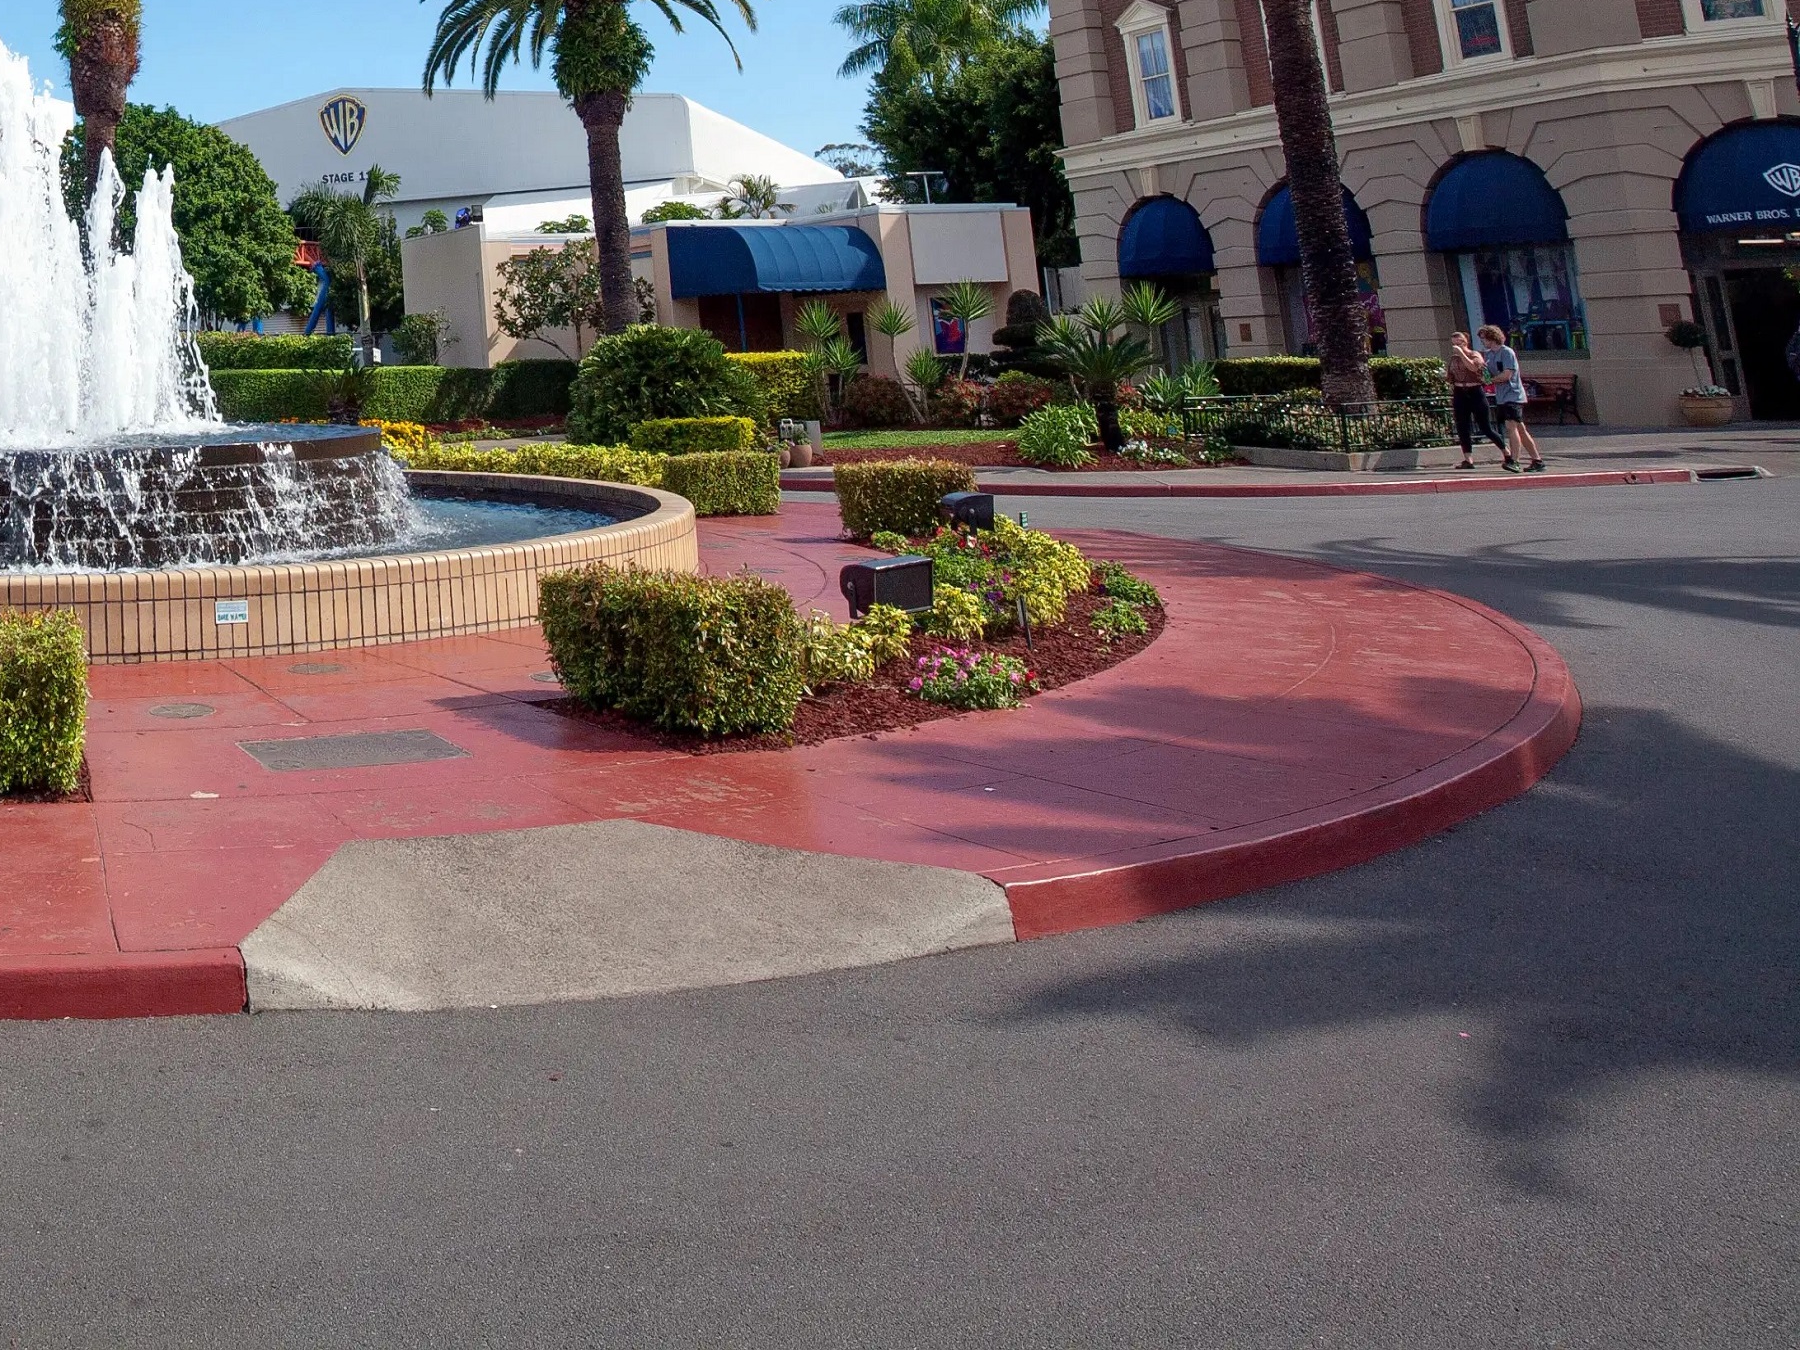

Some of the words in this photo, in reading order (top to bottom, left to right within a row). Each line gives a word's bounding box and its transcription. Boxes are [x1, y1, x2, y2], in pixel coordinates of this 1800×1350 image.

[321, 100, 360, 152] WB
[321, 172, 355, 184] STAGE
[1706, 211, 1752, 224] WARNER
[1755, 209, 1790, 220] BROS.
